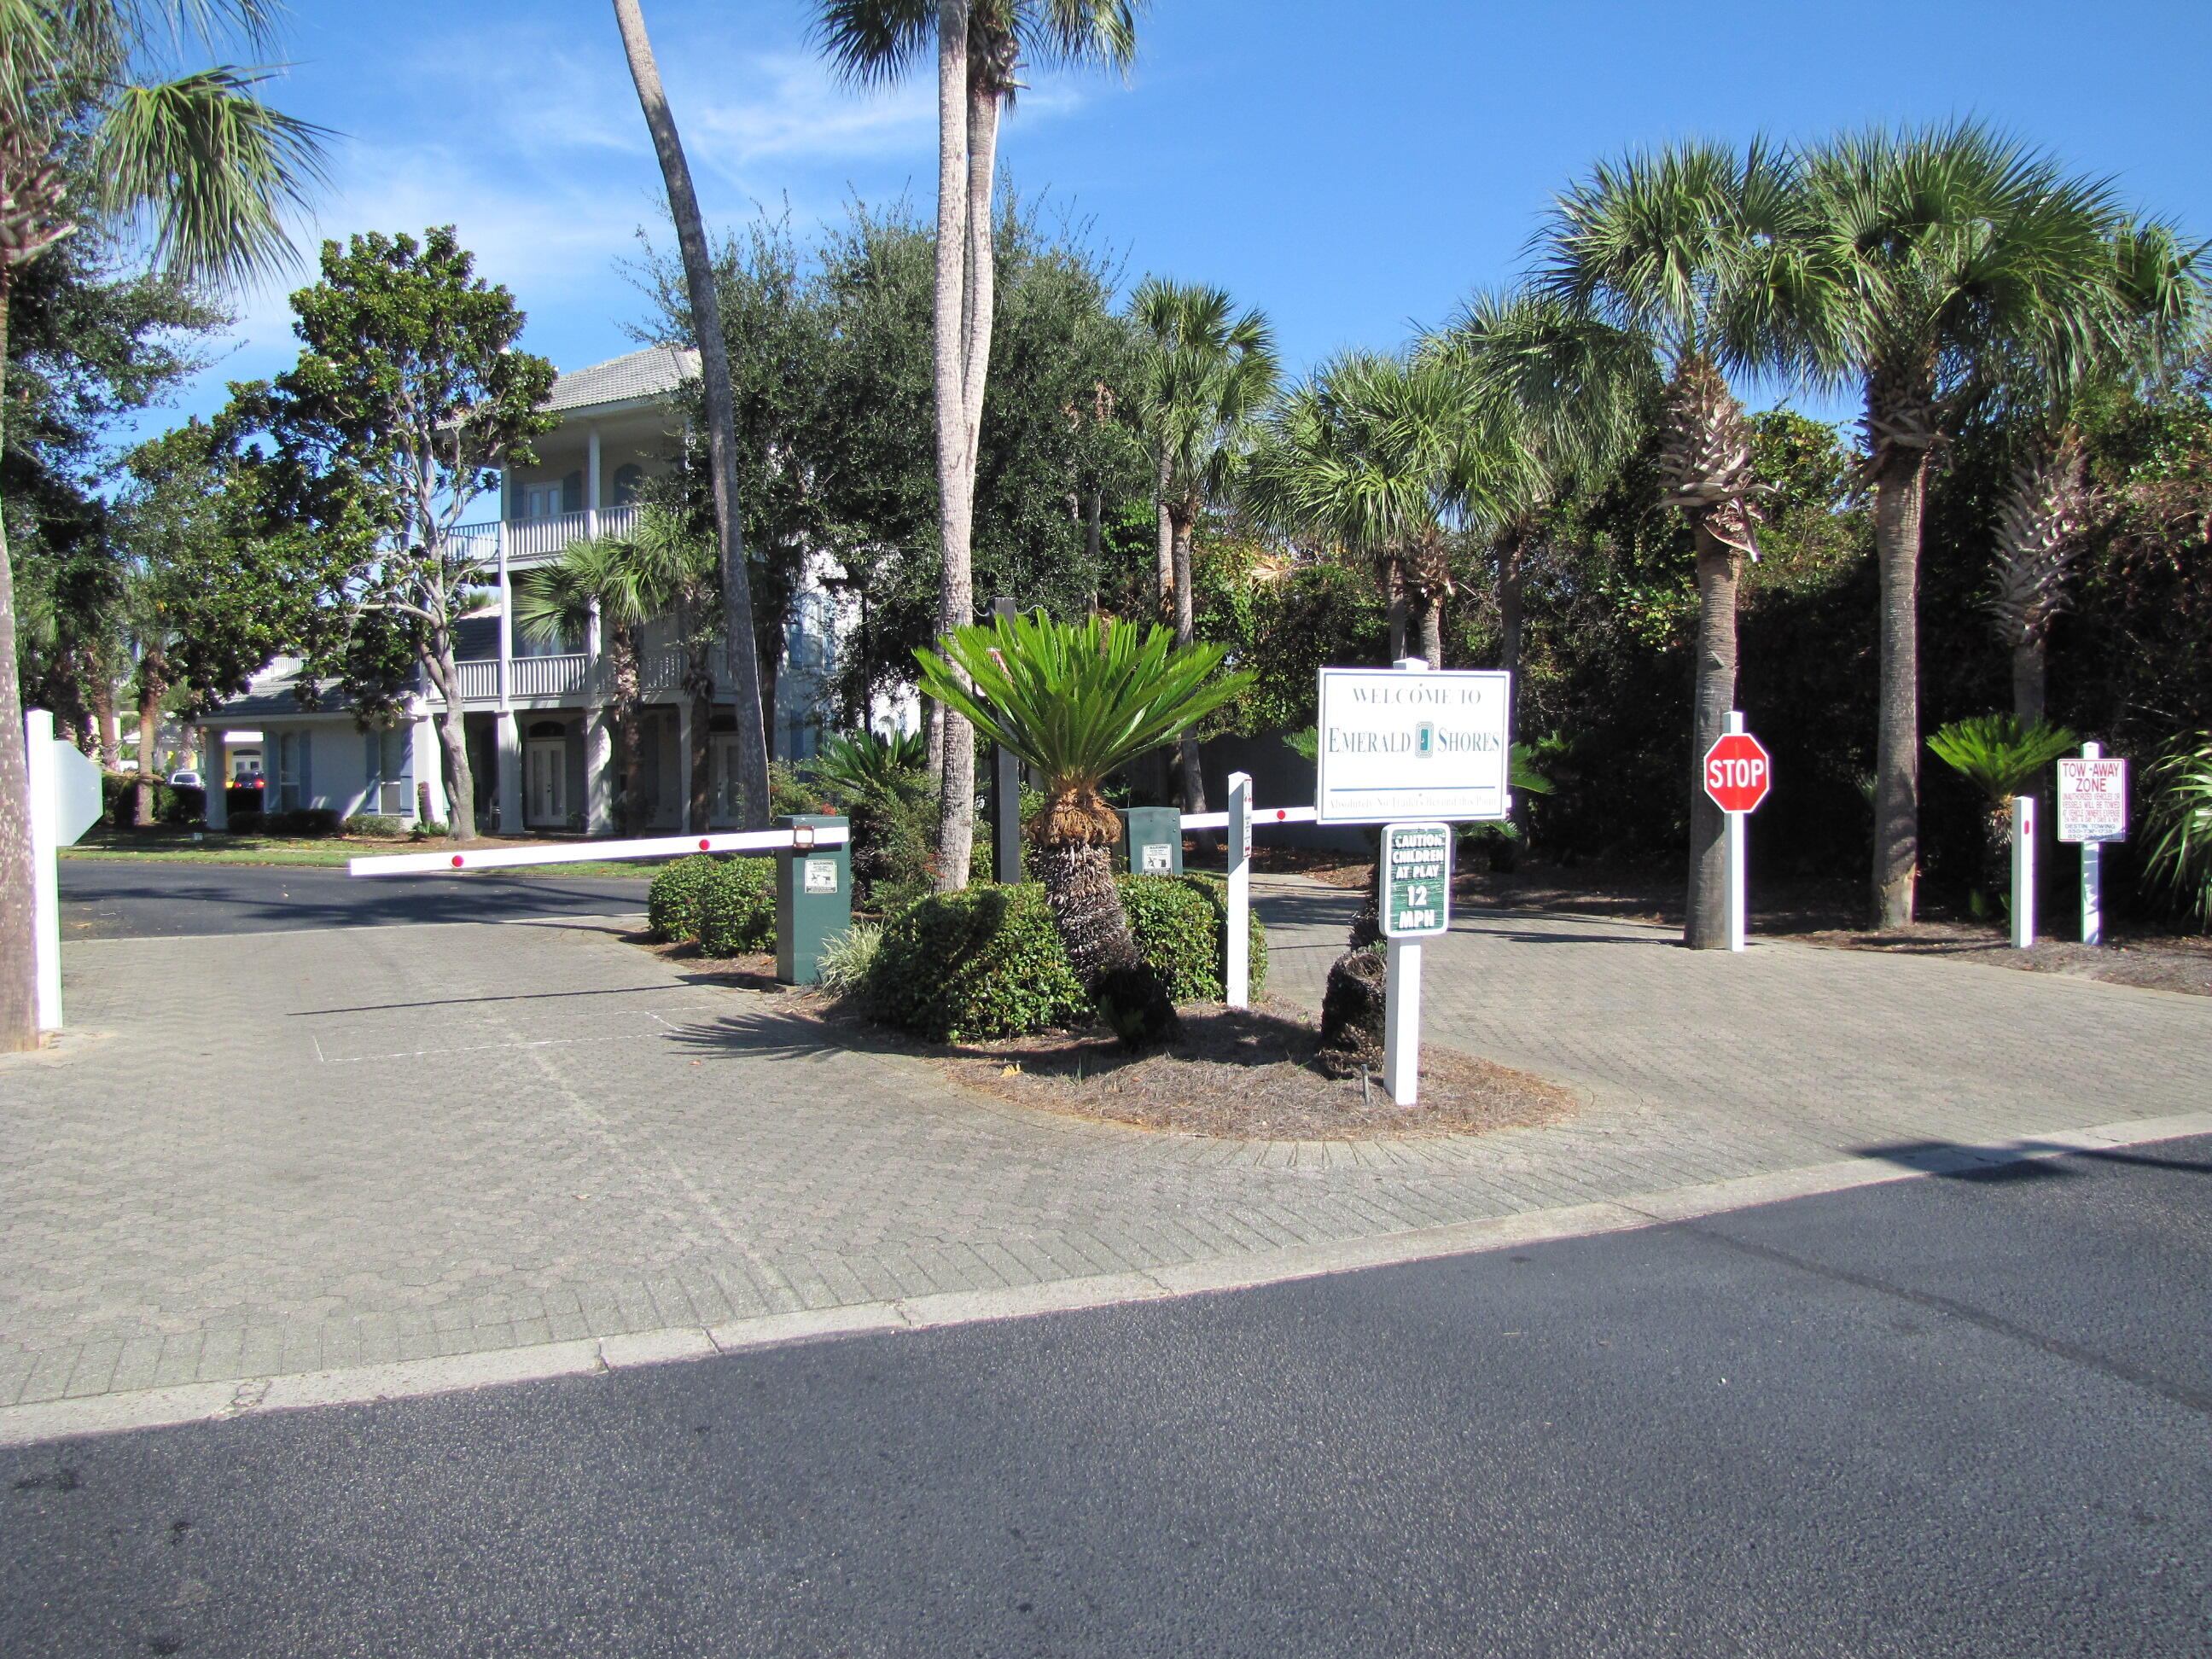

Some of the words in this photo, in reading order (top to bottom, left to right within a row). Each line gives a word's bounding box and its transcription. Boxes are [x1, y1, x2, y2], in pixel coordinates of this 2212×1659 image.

[1353, 688, 1450, 704] WELCOME
[1459, 689, 1481, 704] TO
[1328, 727, 1411, 753] EMERALD
[1437, 727, 1499, 752] SHORES
[1709, 759, 1764, 788] STOP
[2075, 778, 2106, 792] ZONE
[1392, 849, 1444, 864] CHILDREN
[1396, 866, 1410, 879] AT
[1412, 864, 1440, 878] PLAY
[1407, 885, 1428, 906] 12
[1399, 910, 1435, 928] MPH
